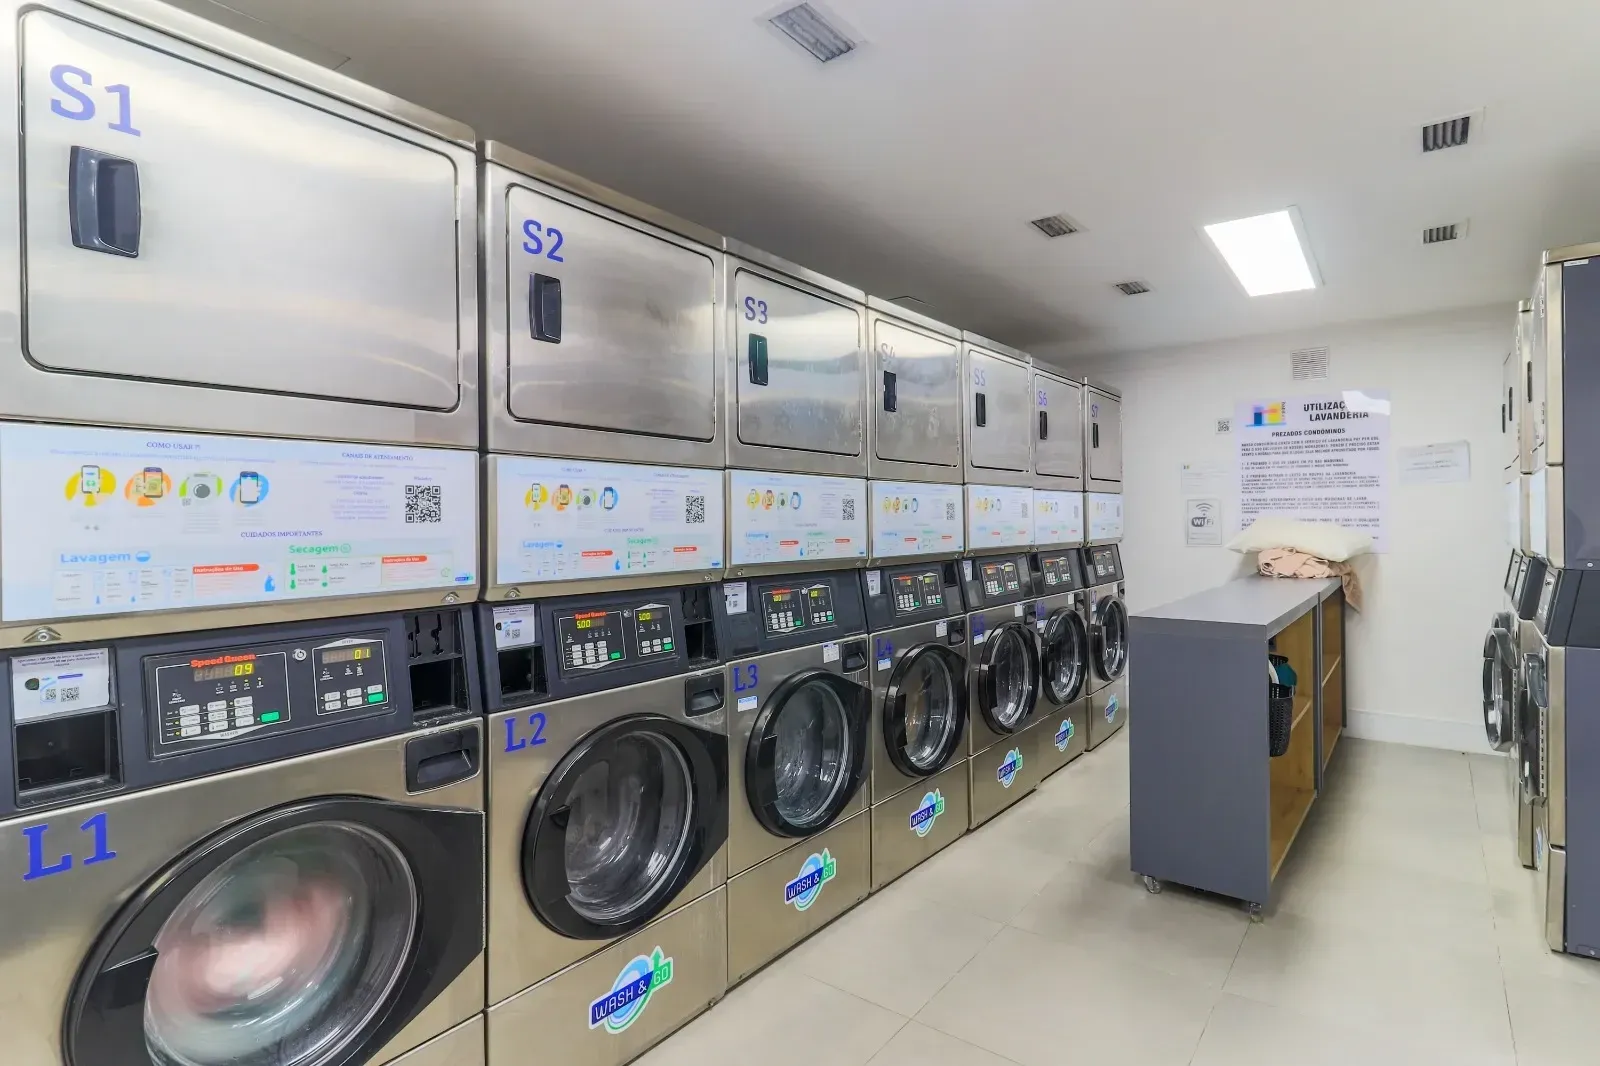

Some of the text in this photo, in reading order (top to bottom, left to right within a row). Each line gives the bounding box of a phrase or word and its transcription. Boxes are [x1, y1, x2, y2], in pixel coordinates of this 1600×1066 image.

[50, 64, 141, 137] S1
[523, 219, 564, 263] S2
[744, 296, 768, 325] S3
[974, 367, 986, 387] S5
[1038, 390, 1048, 407] S6
[1303, 400, 1346, 411] UTILIZAÇ
[1091, 404, 1098, 418] S7
[1309, 411, 1369, 422] LAVANDERIA
[1272, 430, 1303, 438] PREZADOS
[373, 453, 413, 461] ATENDIMENTO
[277, 530, 323, 538] IMPORTANTES
[289, 543, 339, 554] Secagem
[522, 540, 554, 549] Lavagem
[626, 537, 651, 546] Secagem
[60, 552, 131, 565] Lavagem
[190, 654, 256, 668] Speed Queen
[234, 663, 253, 676] 09
[733, 664, 758, 693] L3
[504, 712, 548, 752] L2
[912, 810, 928, 827] WASH
[928, 807, 933, 816] &
[22, 811, 117, 881] L1
[787, 863, 834, 900] WASH & GO
[594, 965, 669, 1021] WASH & GO
